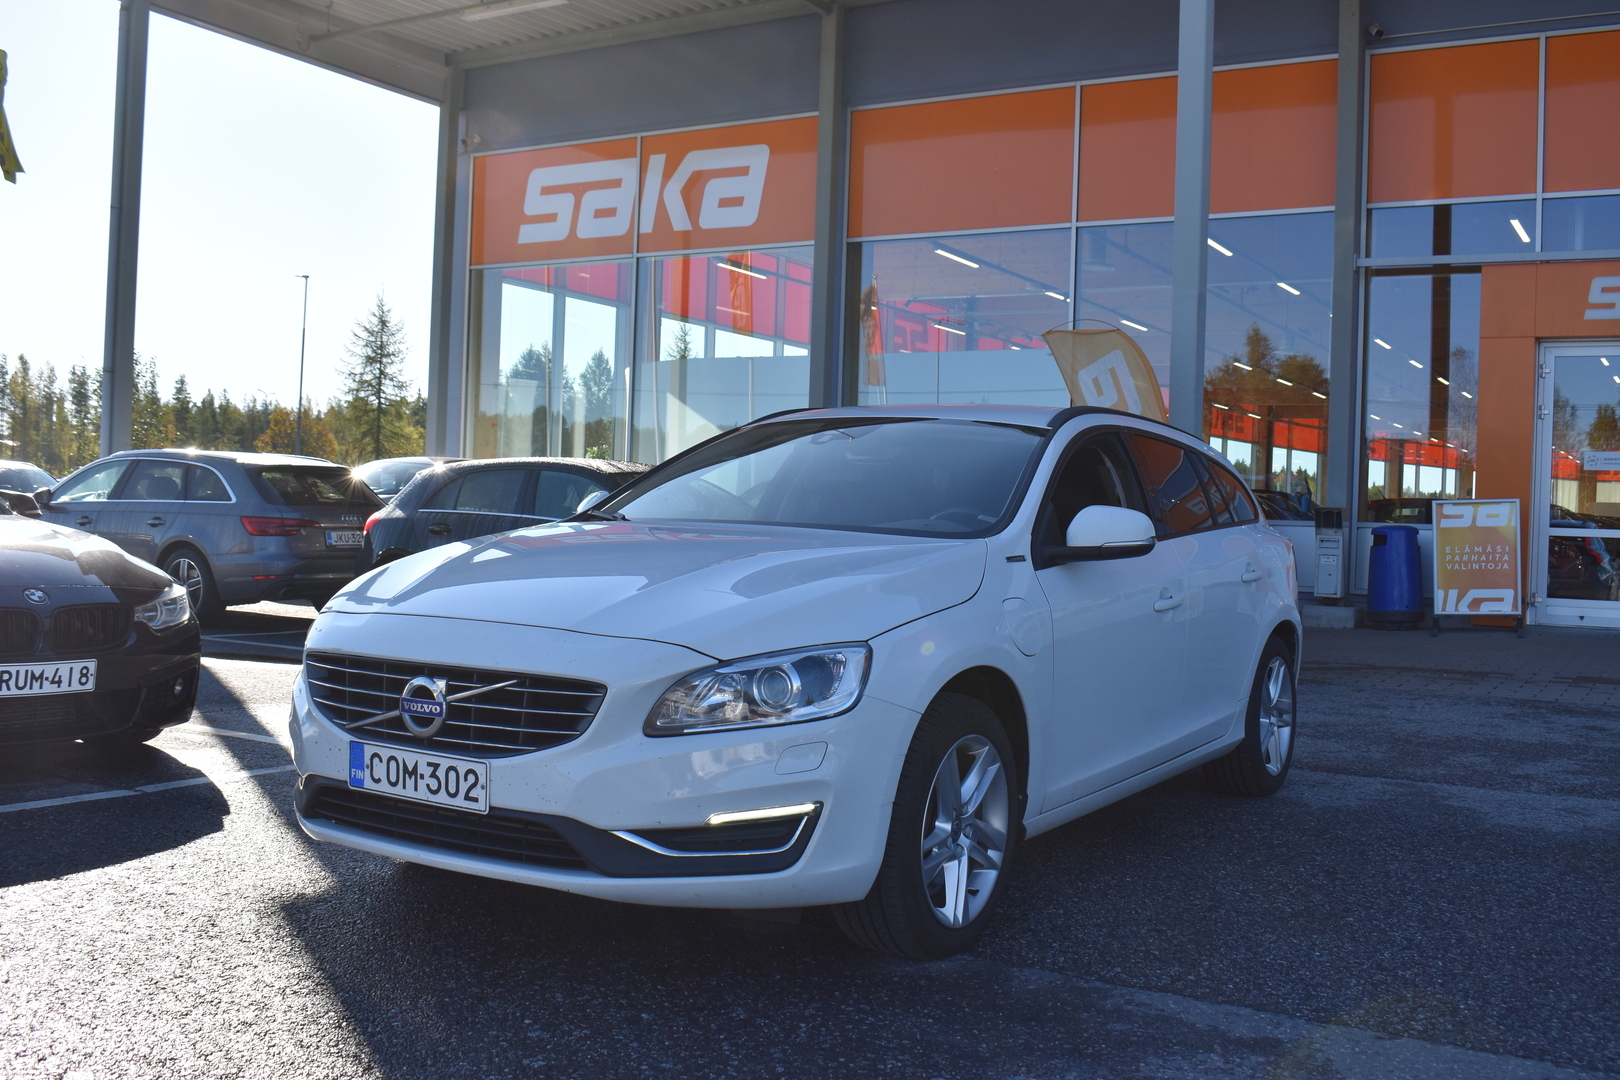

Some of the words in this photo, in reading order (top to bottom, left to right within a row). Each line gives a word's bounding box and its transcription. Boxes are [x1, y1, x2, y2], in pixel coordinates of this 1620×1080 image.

[1445, 544, 1509, 553] ELÄMÄSI
[1445, 554, 1509, 562] PARHAITA
[1445, 562, 1510, 570] VALINTOJA
[0, 665, 90, 692] RUM-418
[402, 701, 441, 714] VOLVO
[351, 768, 364, 780] FIN
[369, 751, 480, 804] COM-302
